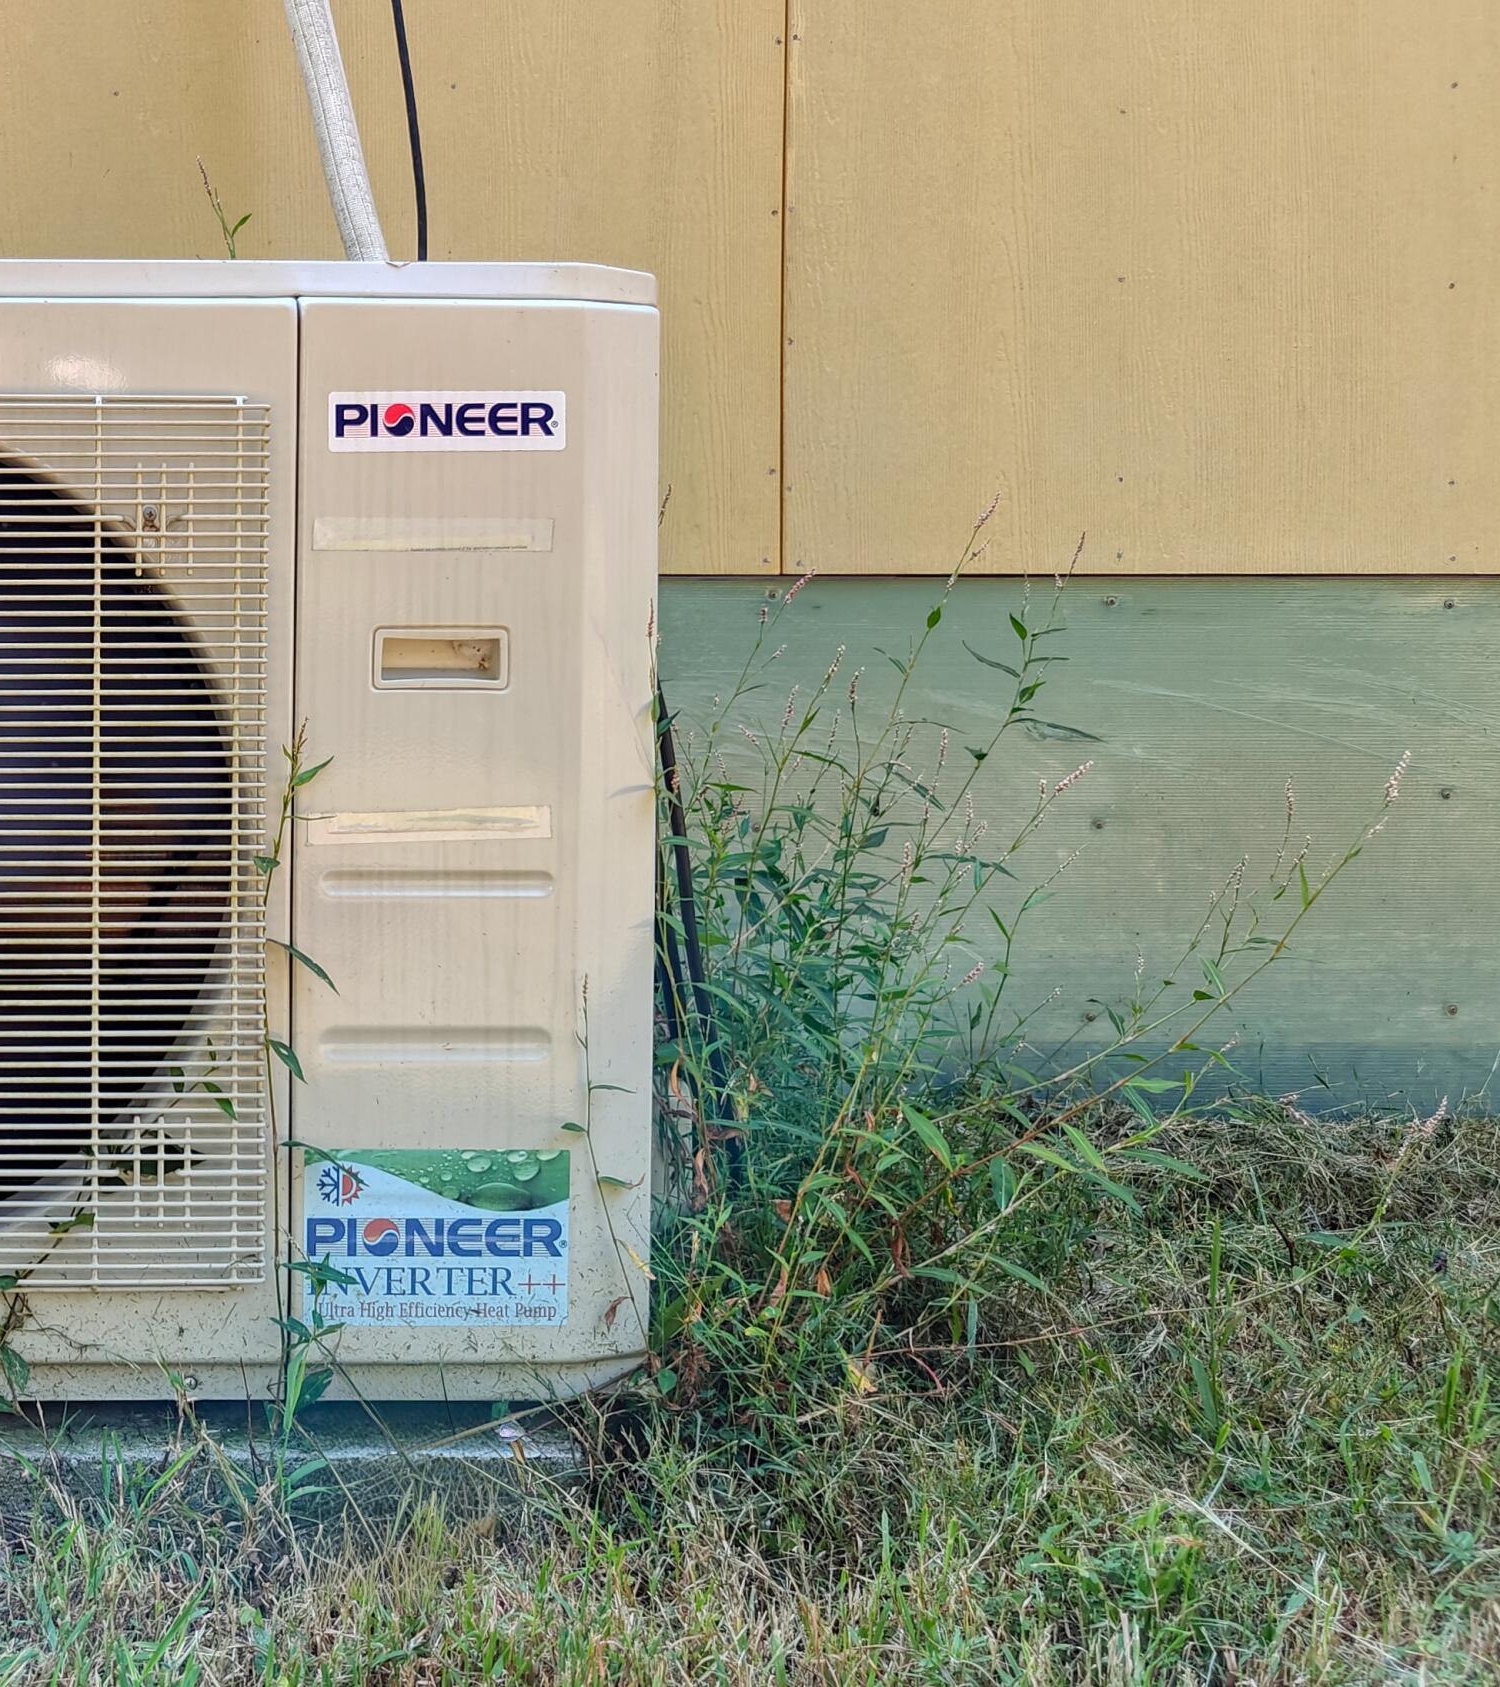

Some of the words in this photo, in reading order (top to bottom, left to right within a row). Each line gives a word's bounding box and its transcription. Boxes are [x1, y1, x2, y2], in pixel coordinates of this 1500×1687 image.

[318, 1301, 354, 1320] Ultra
[359, 1301, 394, 1320] High
[400, 1302, 470, 1320] Efficiency
[476, 1302, 509, 1318] Heat
[515, 1302, 557, 1318] Pump
